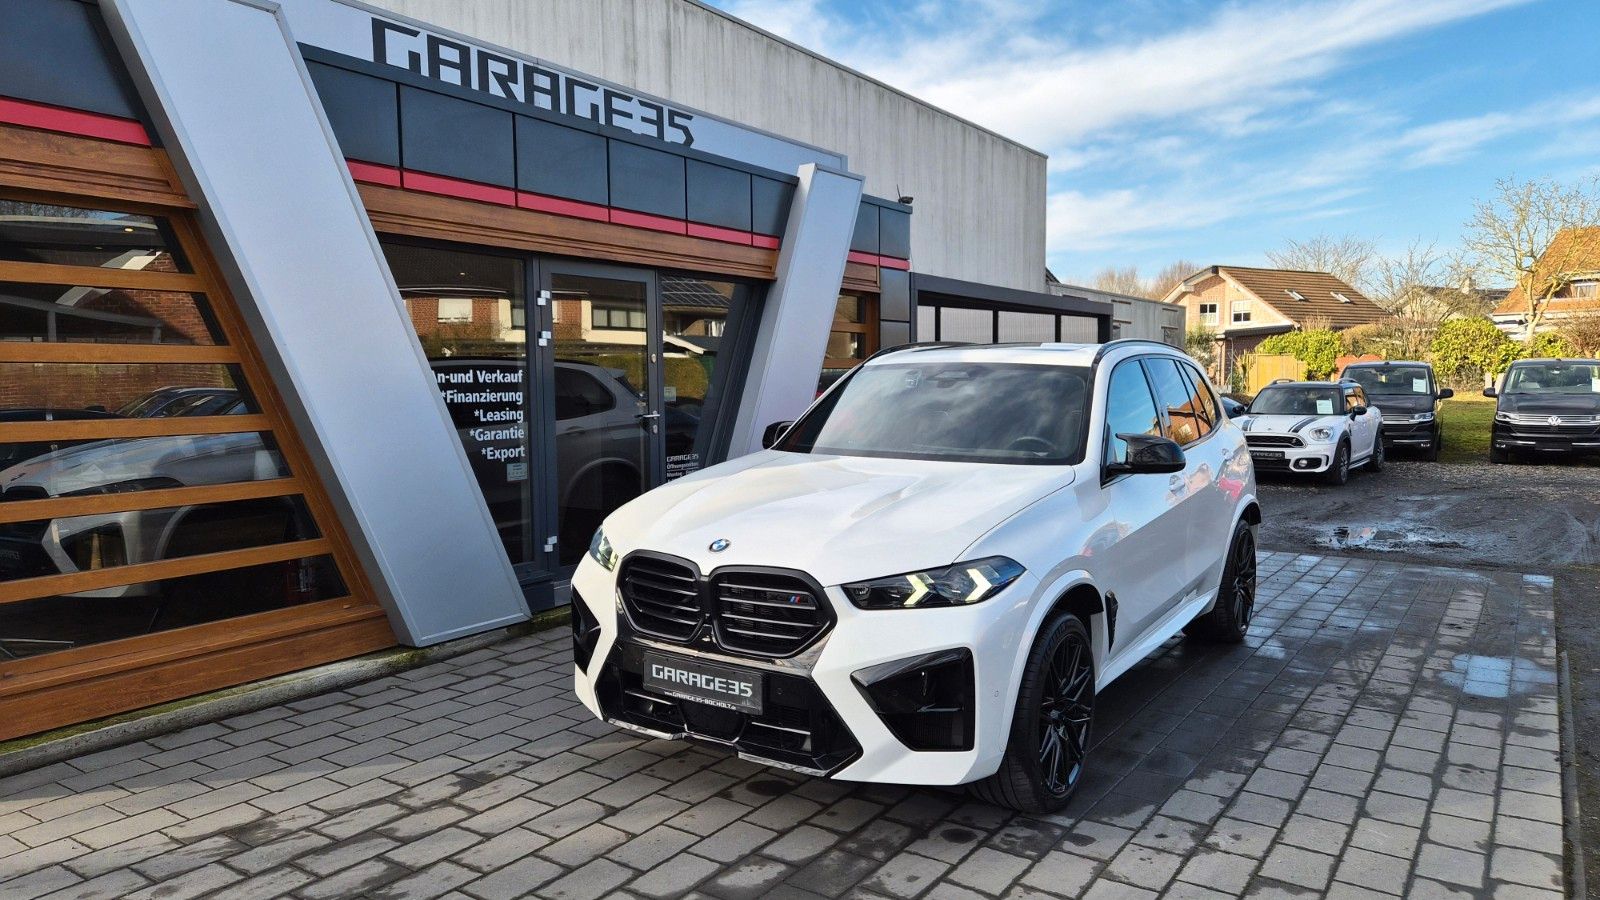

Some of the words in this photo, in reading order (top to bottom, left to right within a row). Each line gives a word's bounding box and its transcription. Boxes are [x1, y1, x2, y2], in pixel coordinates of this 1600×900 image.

[371, 17, 695, 148] GARAGE35
[476, 369, 523, 383] Verkauf
[652, 664, 753, 698] GARAGE35
